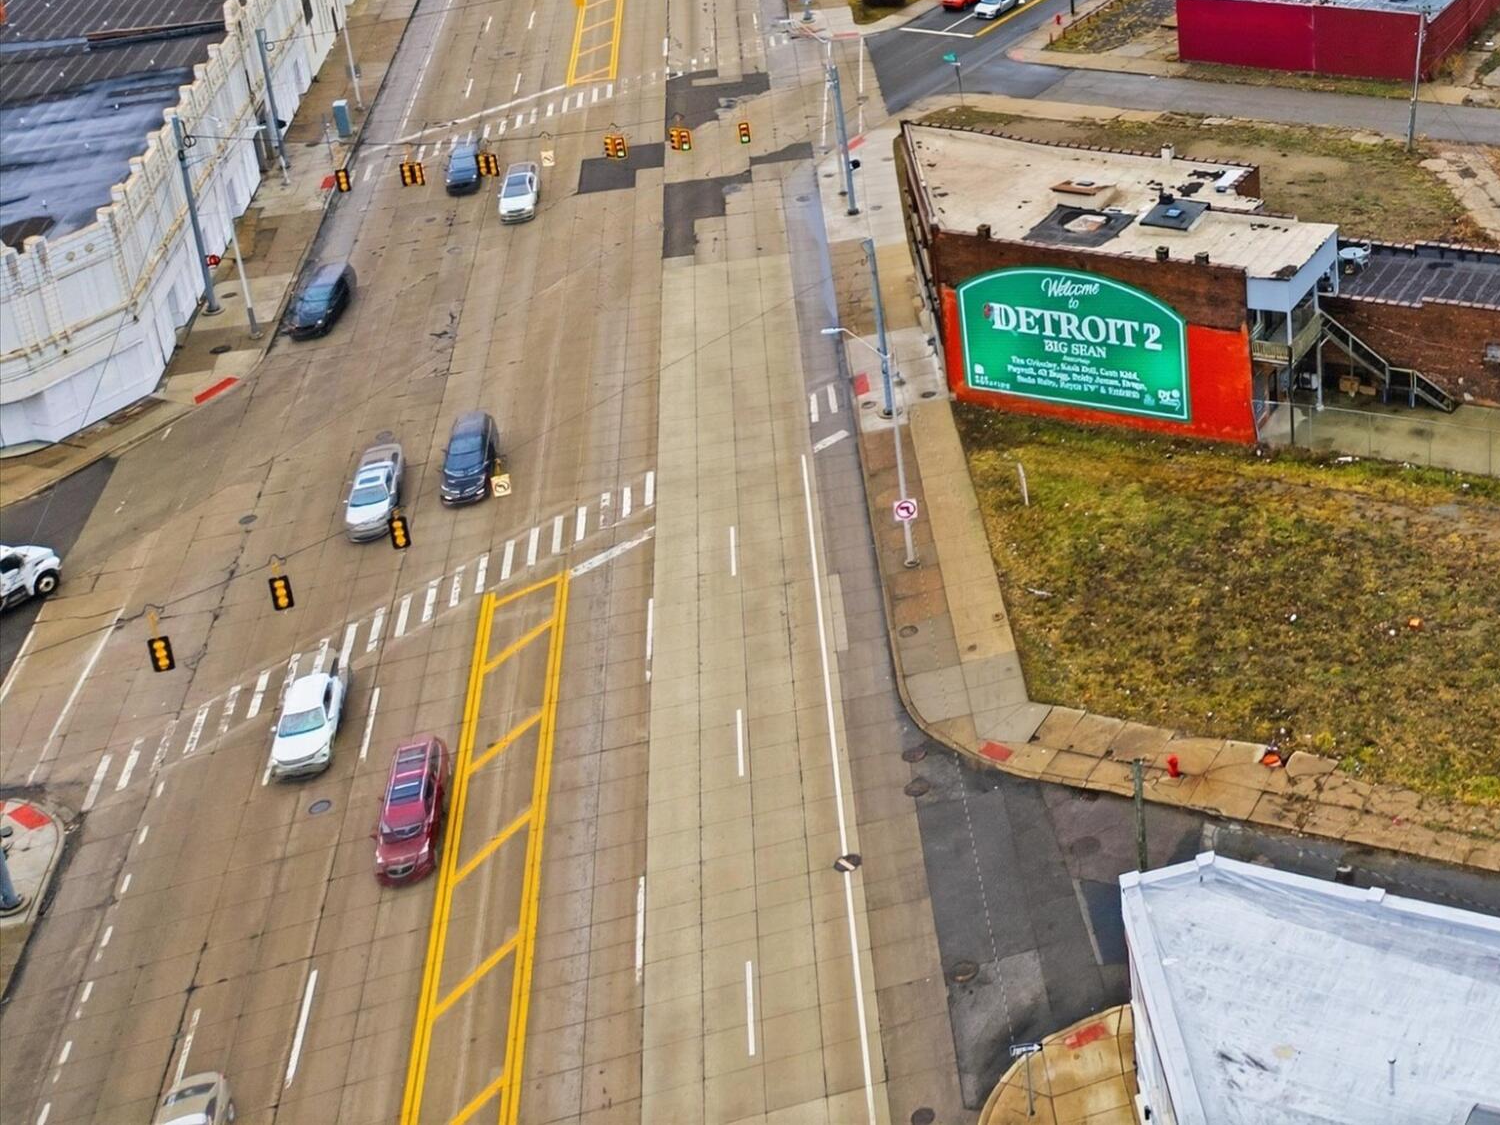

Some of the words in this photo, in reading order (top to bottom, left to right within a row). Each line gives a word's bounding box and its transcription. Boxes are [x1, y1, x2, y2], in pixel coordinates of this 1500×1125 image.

[1041, 276, 1100, 297] Welcome
[1069, 297, 1080, 309] to
[990, 302, 1139, 347] DETROIT
[1143, 322, 1163, 351] 2
[1044, 339, 1068, 354] BIG
[1071, 342, 1107, 359] SEAN
